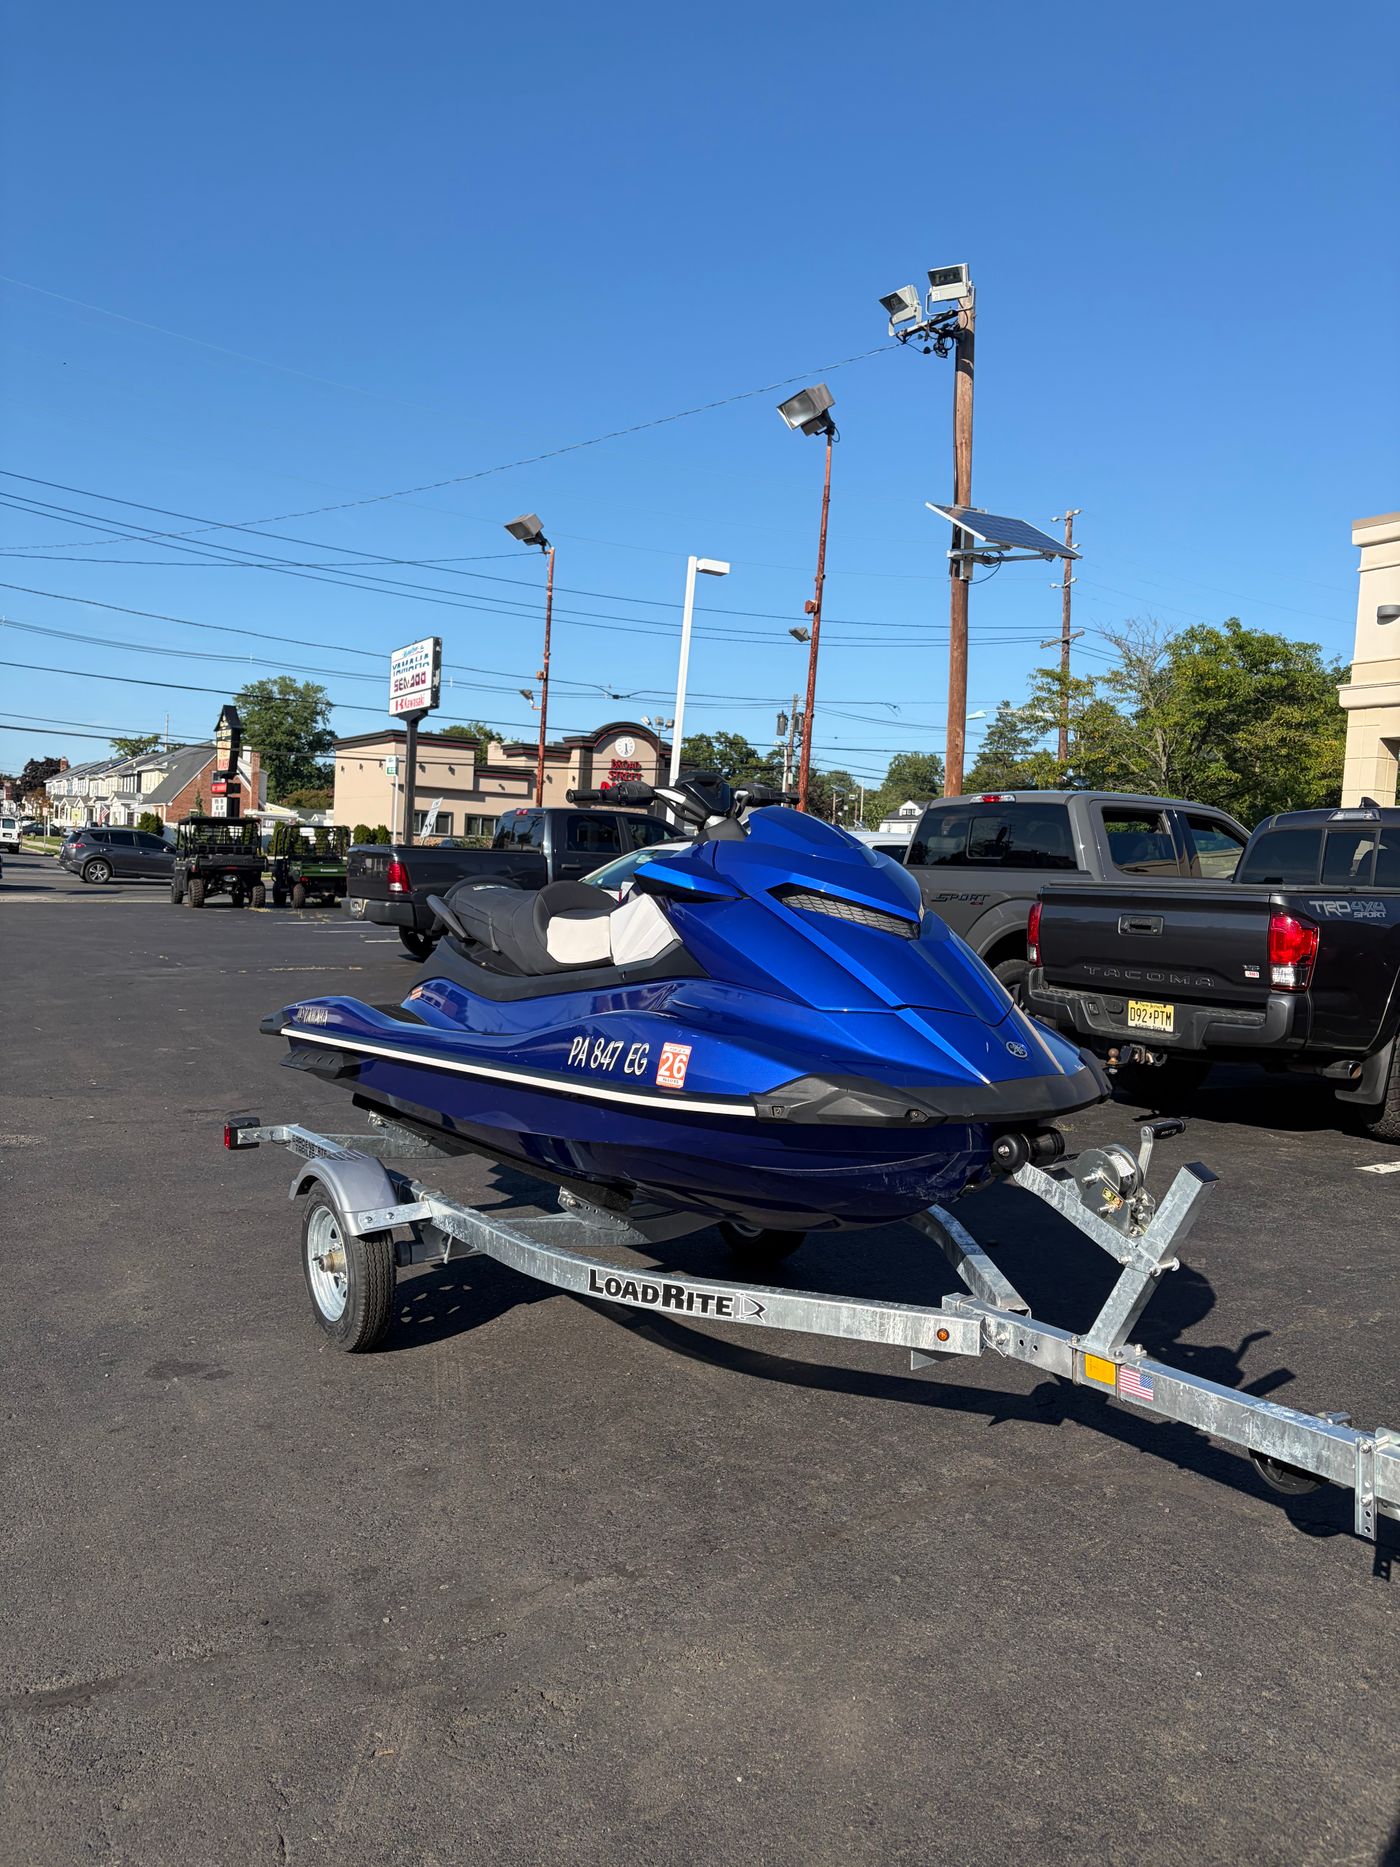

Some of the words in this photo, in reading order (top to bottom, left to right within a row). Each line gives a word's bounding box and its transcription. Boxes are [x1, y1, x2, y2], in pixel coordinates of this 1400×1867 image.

[931, 893, 991, 903] SPORT
[1309, 901, 1351, 916] TRD
[1083, 964, 1215, 987] TACOMA
[1130, 1007, 1147, 1023] D92
[1153, 1010, 1171, 1026] PTM
[568, 1036, 591, 1067] PA
[590, 1037, 624, 1071] 847
[623, 1042, 650, 1076] EG
[659, 1052, 687, 1079] 26
